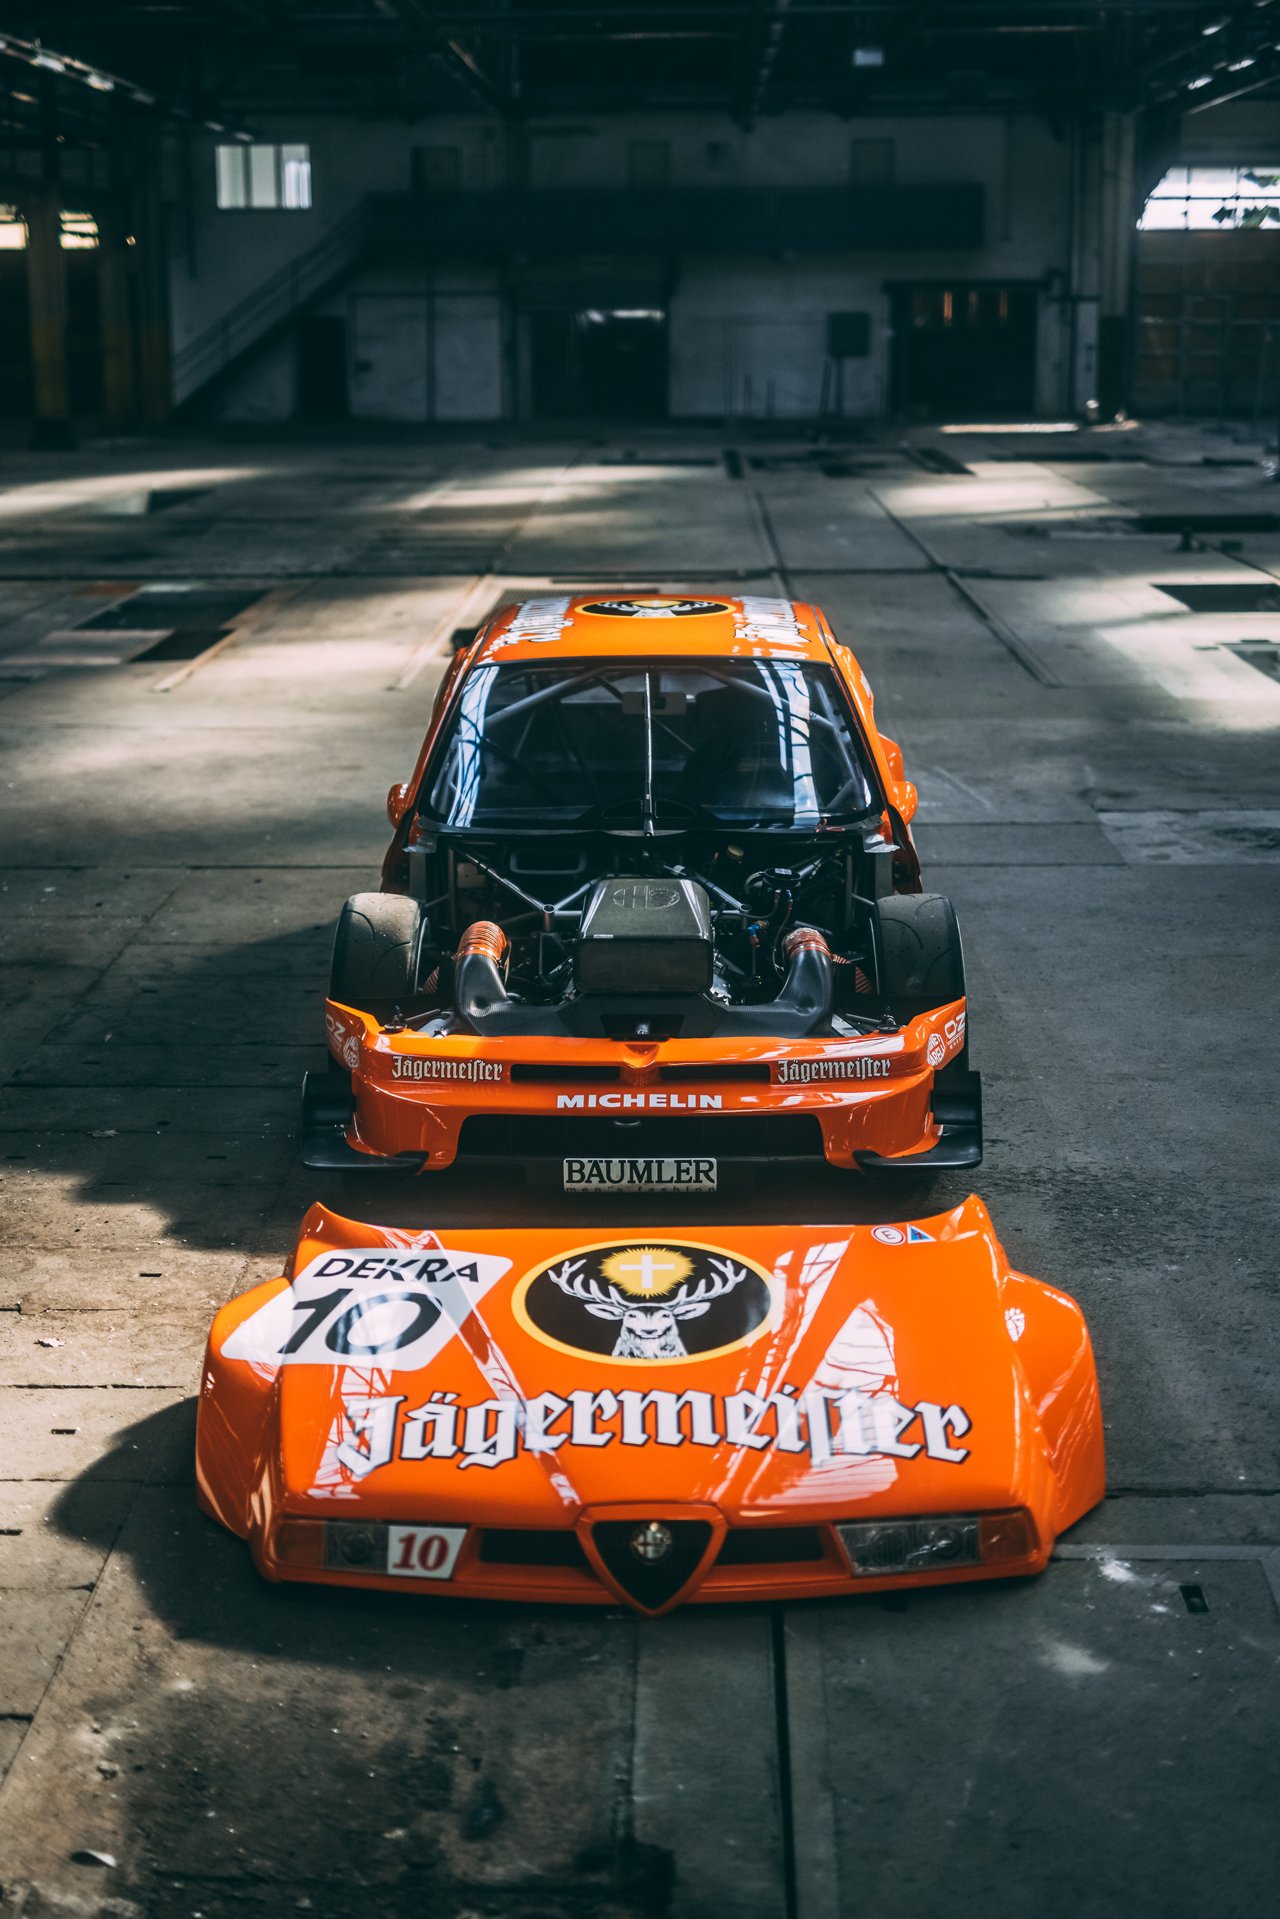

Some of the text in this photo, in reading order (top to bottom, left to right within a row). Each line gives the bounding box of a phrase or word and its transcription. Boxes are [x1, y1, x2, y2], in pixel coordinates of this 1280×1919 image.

[556, 1093, 723, 1109] MICHELIN
[565, 1159, 716, 1184] BÄUMLER
[312, 1258, 479, 1283] DEKRA
[277, 1288, 443, 1356] 10
[392, 1531, 450, 1572] 10
